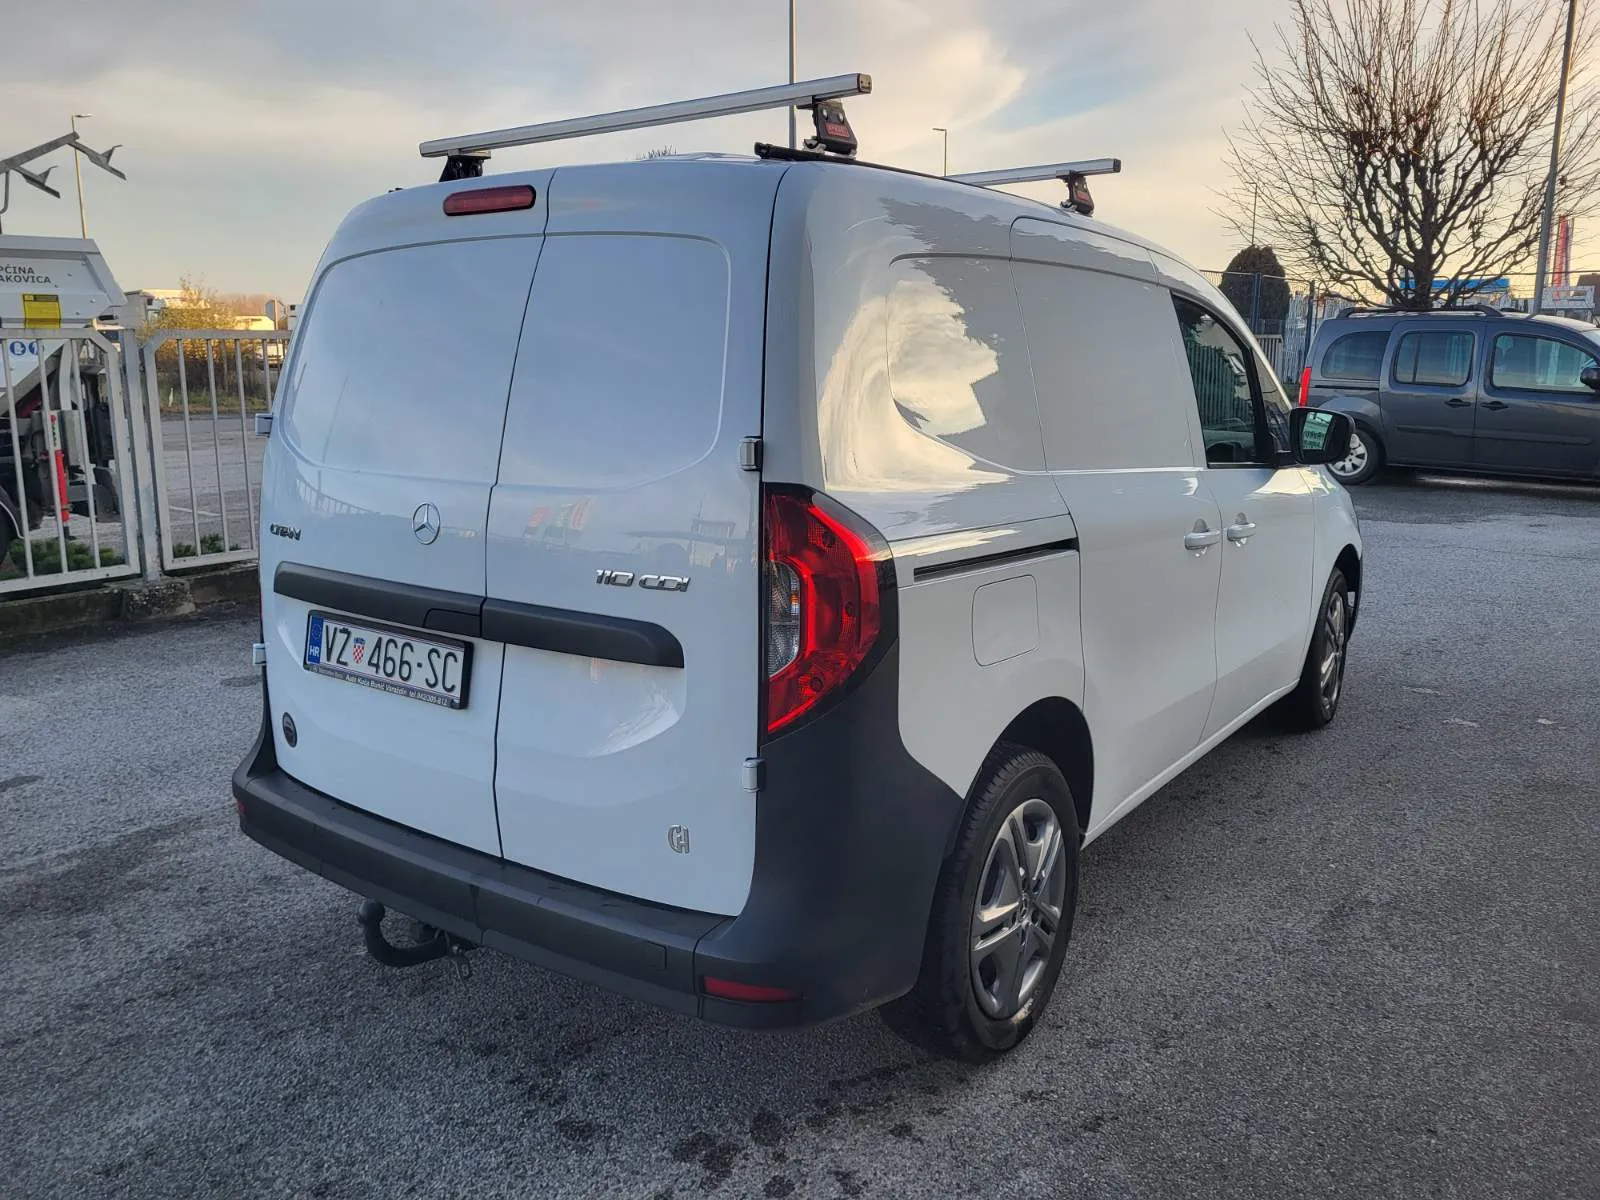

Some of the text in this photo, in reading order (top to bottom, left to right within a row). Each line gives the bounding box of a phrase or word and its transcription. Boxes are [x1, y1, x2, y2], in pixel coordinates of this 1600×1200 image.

[596, 569, 691, 592] 110 CDI
[308, 645, 320, 658] HR
[325, 624, 352, 667] VŽ
